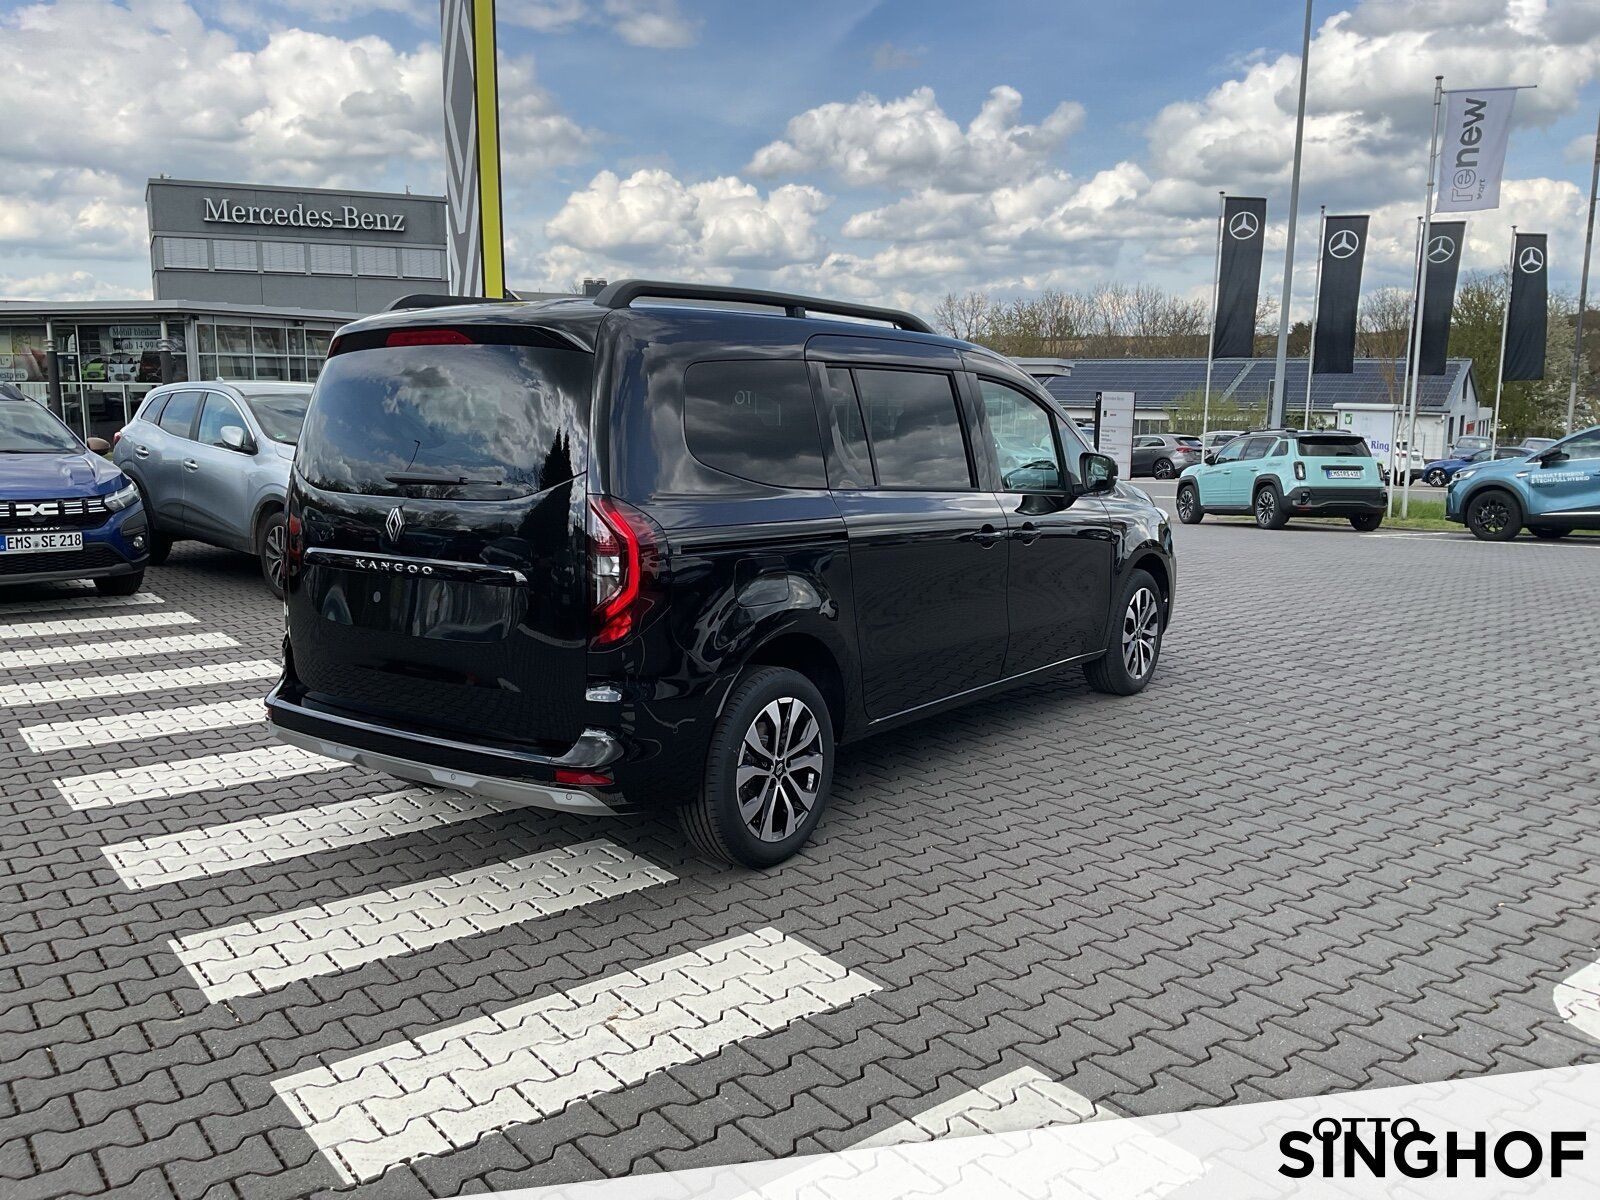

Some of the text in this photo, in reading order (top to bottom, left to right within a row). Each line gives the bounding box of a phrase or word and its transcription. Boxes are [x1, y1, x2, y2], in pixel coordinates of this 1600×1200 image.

[1451, 97, 1487, 202] renew
[203, 197, 405, 232] Mercedes-Benz
[1371, 440, 1390, 452] Ring
[7, 533, 82, 550] EMS SE 218
[355, 558, 433, 575] KANGOO
